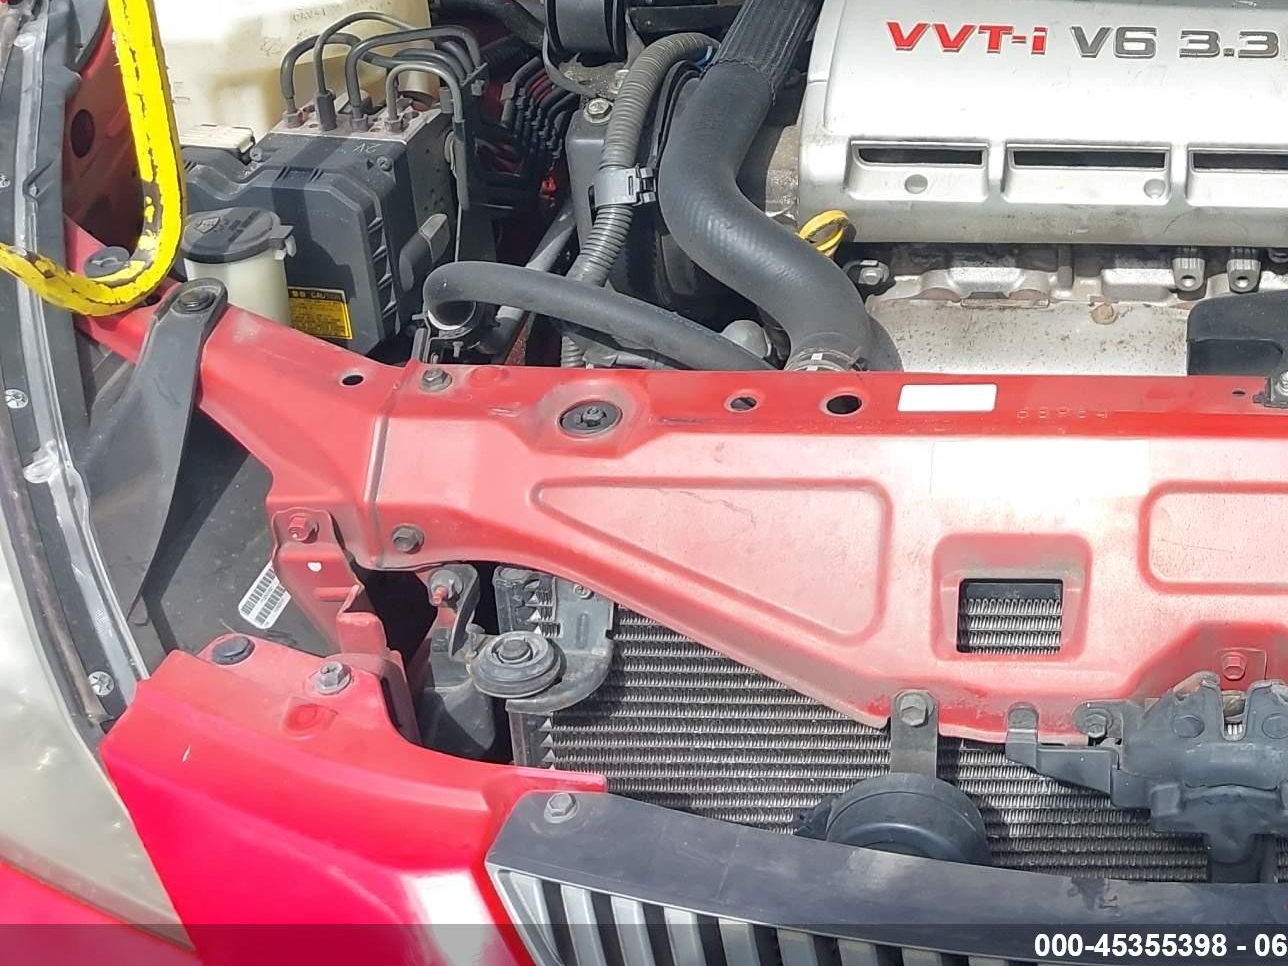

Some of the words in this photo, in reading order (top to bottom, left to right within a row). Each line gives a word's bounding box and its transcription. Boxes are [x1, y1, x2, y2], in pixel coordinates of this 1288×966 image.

[886, 21, 1048, 55] VVT-i
[1070, 26, 1157, 58] V6
[1179, 30, 1279, 58] 3.3
